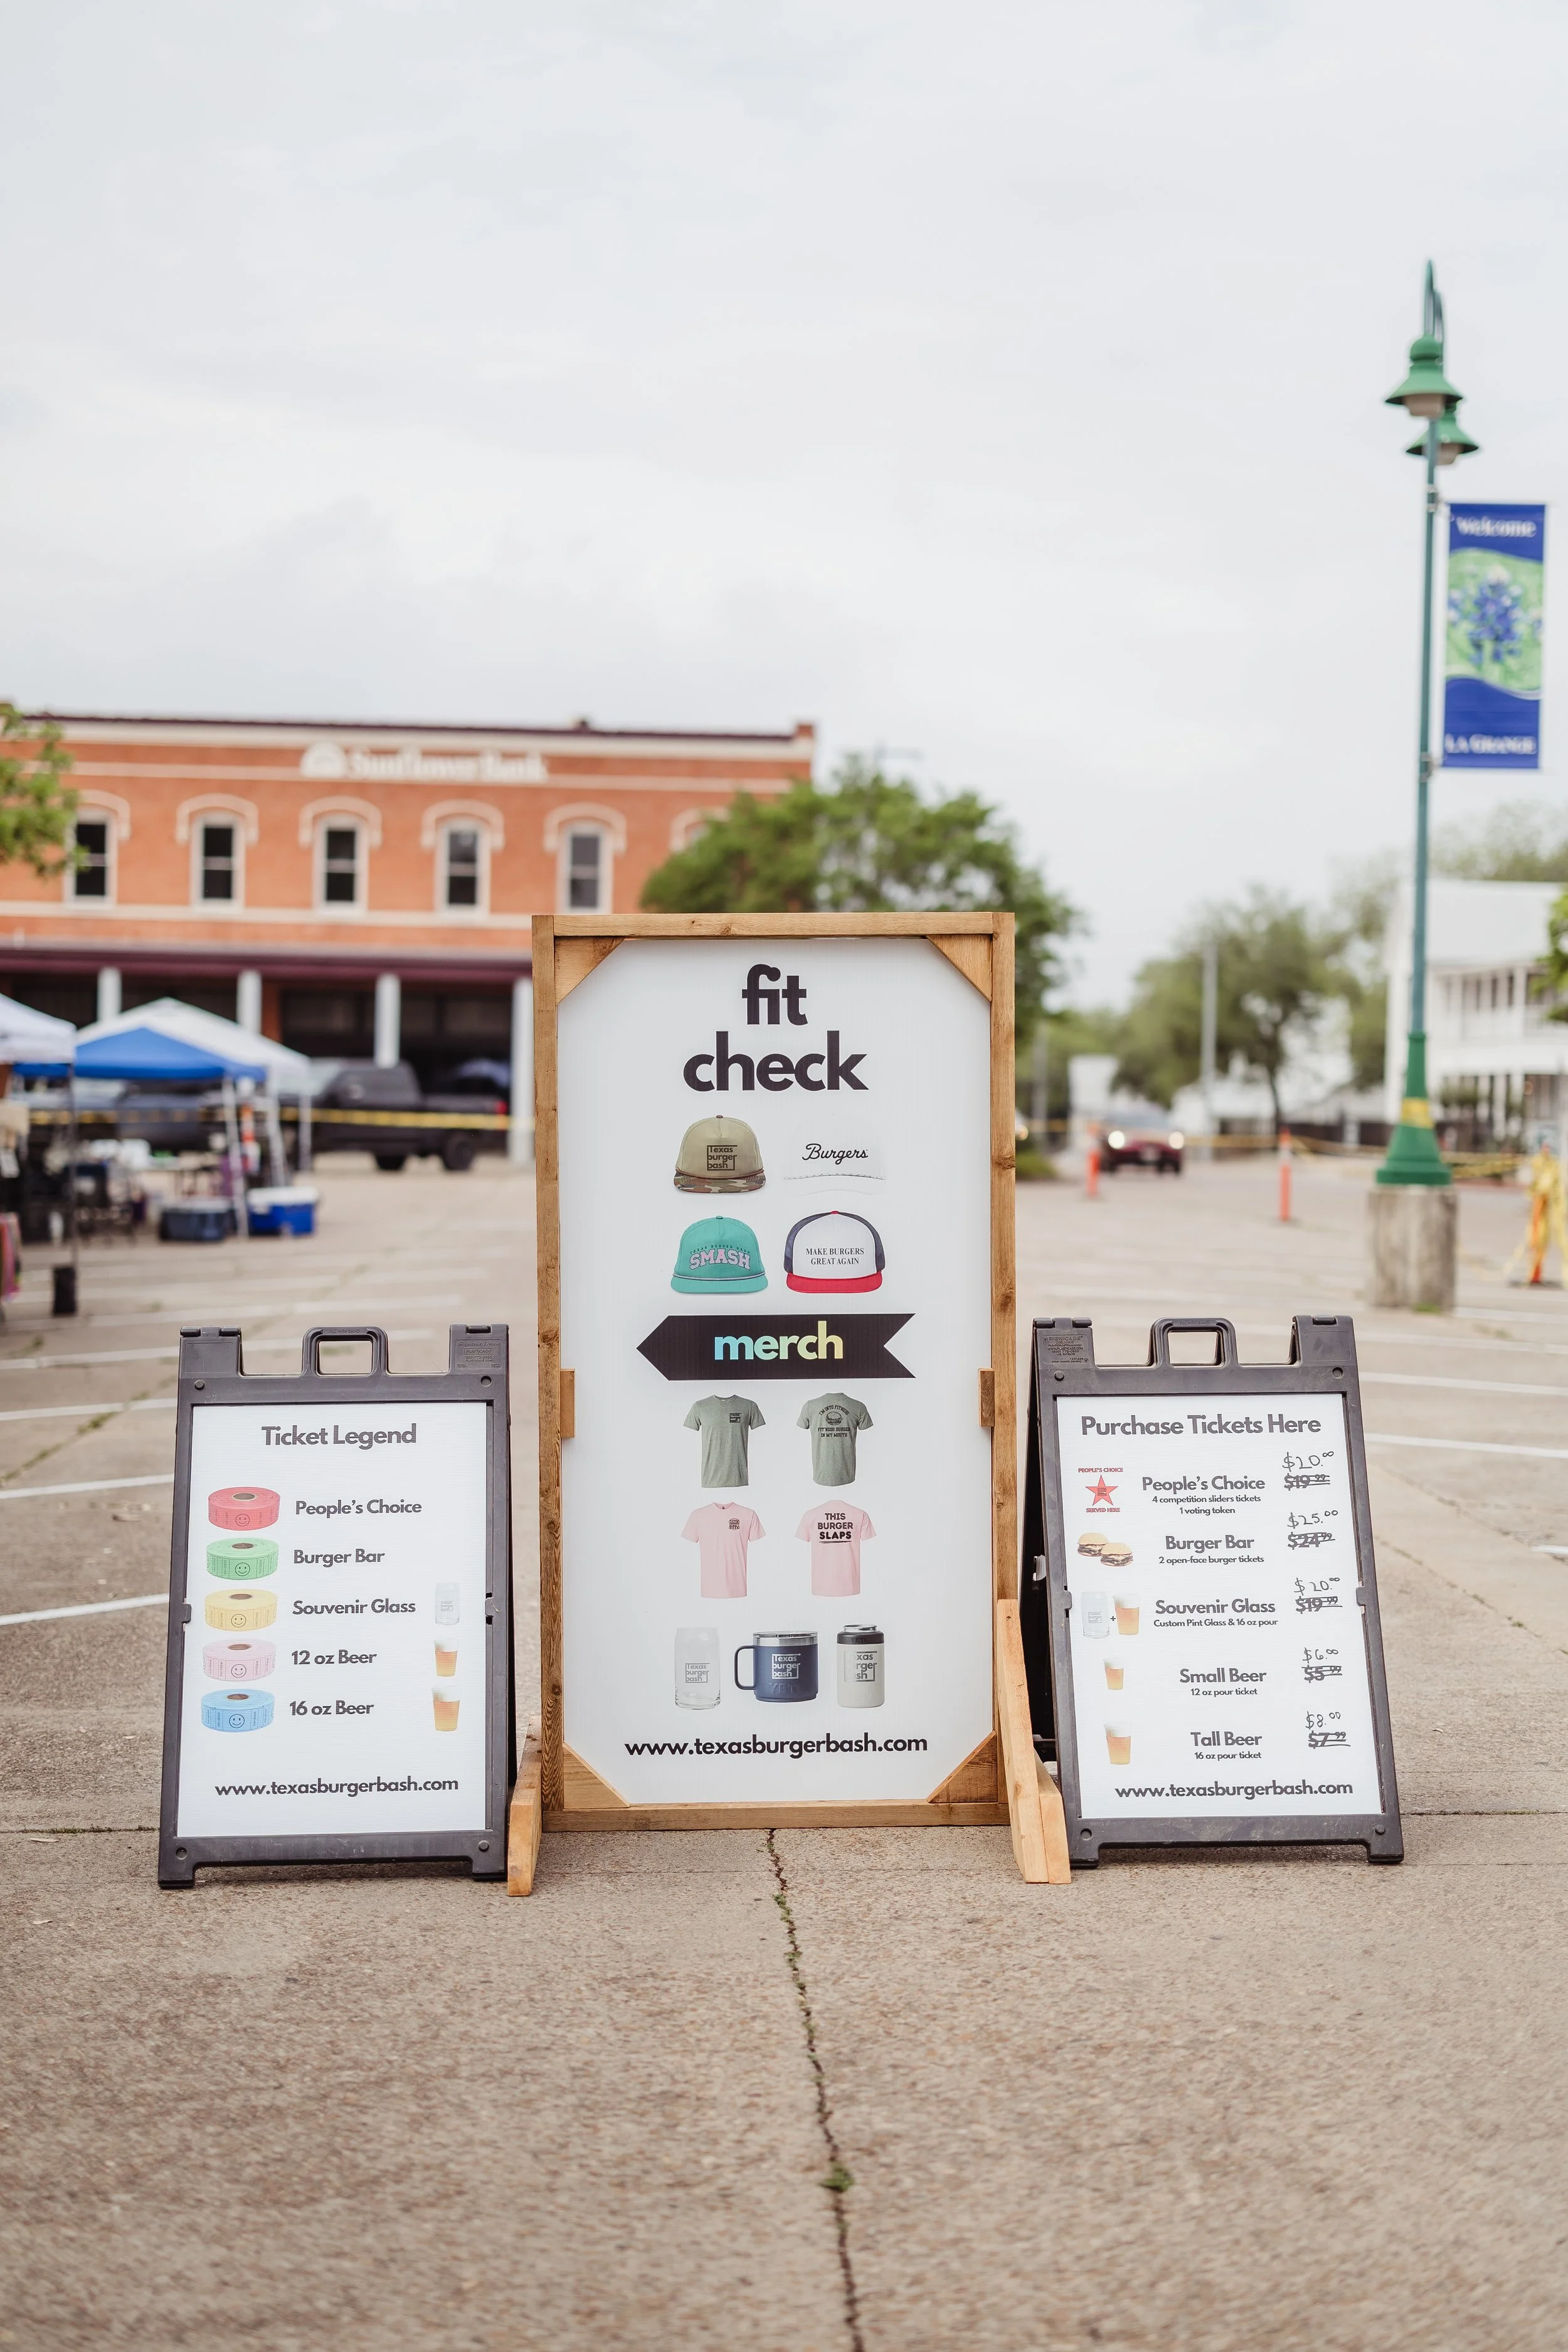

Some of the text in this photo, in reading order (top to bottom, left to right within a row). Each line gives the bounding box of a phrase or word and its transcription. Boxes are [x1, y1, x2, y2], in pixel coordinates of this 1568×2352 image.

[1456, 516, 1536, 538] Welcome
[741, 963, 808, 1026] fit
[683, 1030, 869, 1092] check
[802, 1143, 868, 1165] Burgers
[707, 1160, 728, 1168] bash
[689, 1248, 751, 1271] SMASH
[714, 1320, 844, 1360] merch
[834, 1405, 850, 1416] FITNESS
[1081, 1413, 1322, 1436] Purchase Tickets Here
[261, 1422, 417, 1450] Ticket Legend
[1142, 1475, 1266, 1494] People's Choice
[1159, 1495, 1207, 1505] competition
[1208, 1495, 1234, 1503] sliders
[1235, 1494, 1261, 1502] tickets
[295, 1498, 422, 1519] People's Choice
[1184, 1507, 1210, 1516] voting
[1212, 1506, 1236, 1514] token
[817, 1522, 854, 1530] BURGER
[819, 1531, 852, 1540] SLAPS
[1165, 1534, 1255, 1554] Burger Bar
[294, 1548, 386, 1568] Burger Bar
[1166, 1555, 1207, 1566] open-face
[1208, 1555, 1237, 1565] burger
[1238, 1555, 1264, 1563] tickets
[292, 1597, 416, 1615] Souvenir Glass
[1155, 1597, 1276, 1614] Souvenir Glass
[1204, 1618, 1227, 1626] Glass
[291, 1649, 378, 1665] 12 oz Beer
[775, 1653, 797, 1661] Texas
[772, 1668, 792, 1677] bash
[1179, 1667, 1267, 1683] Small Beer
[1190, 1688, 1200, 1696] 12
[1214, 1690, 1234, 1698] pour
[1235, 1687, 1258, 1695] ticket
[289, 1700, 374, 1716] 16 oz Beer
[624, 1732, 928, 1759] www.texasburgerbash.com
[1190, 1730, 1263, 1747] Tall Beer
[1238, 1751, 1262, 1759] ticket
[214, 1775, 458, 1798] www.texasburgerbash.com
[1114, 1779, 1353, 1800] www.texasburgerbash.com
